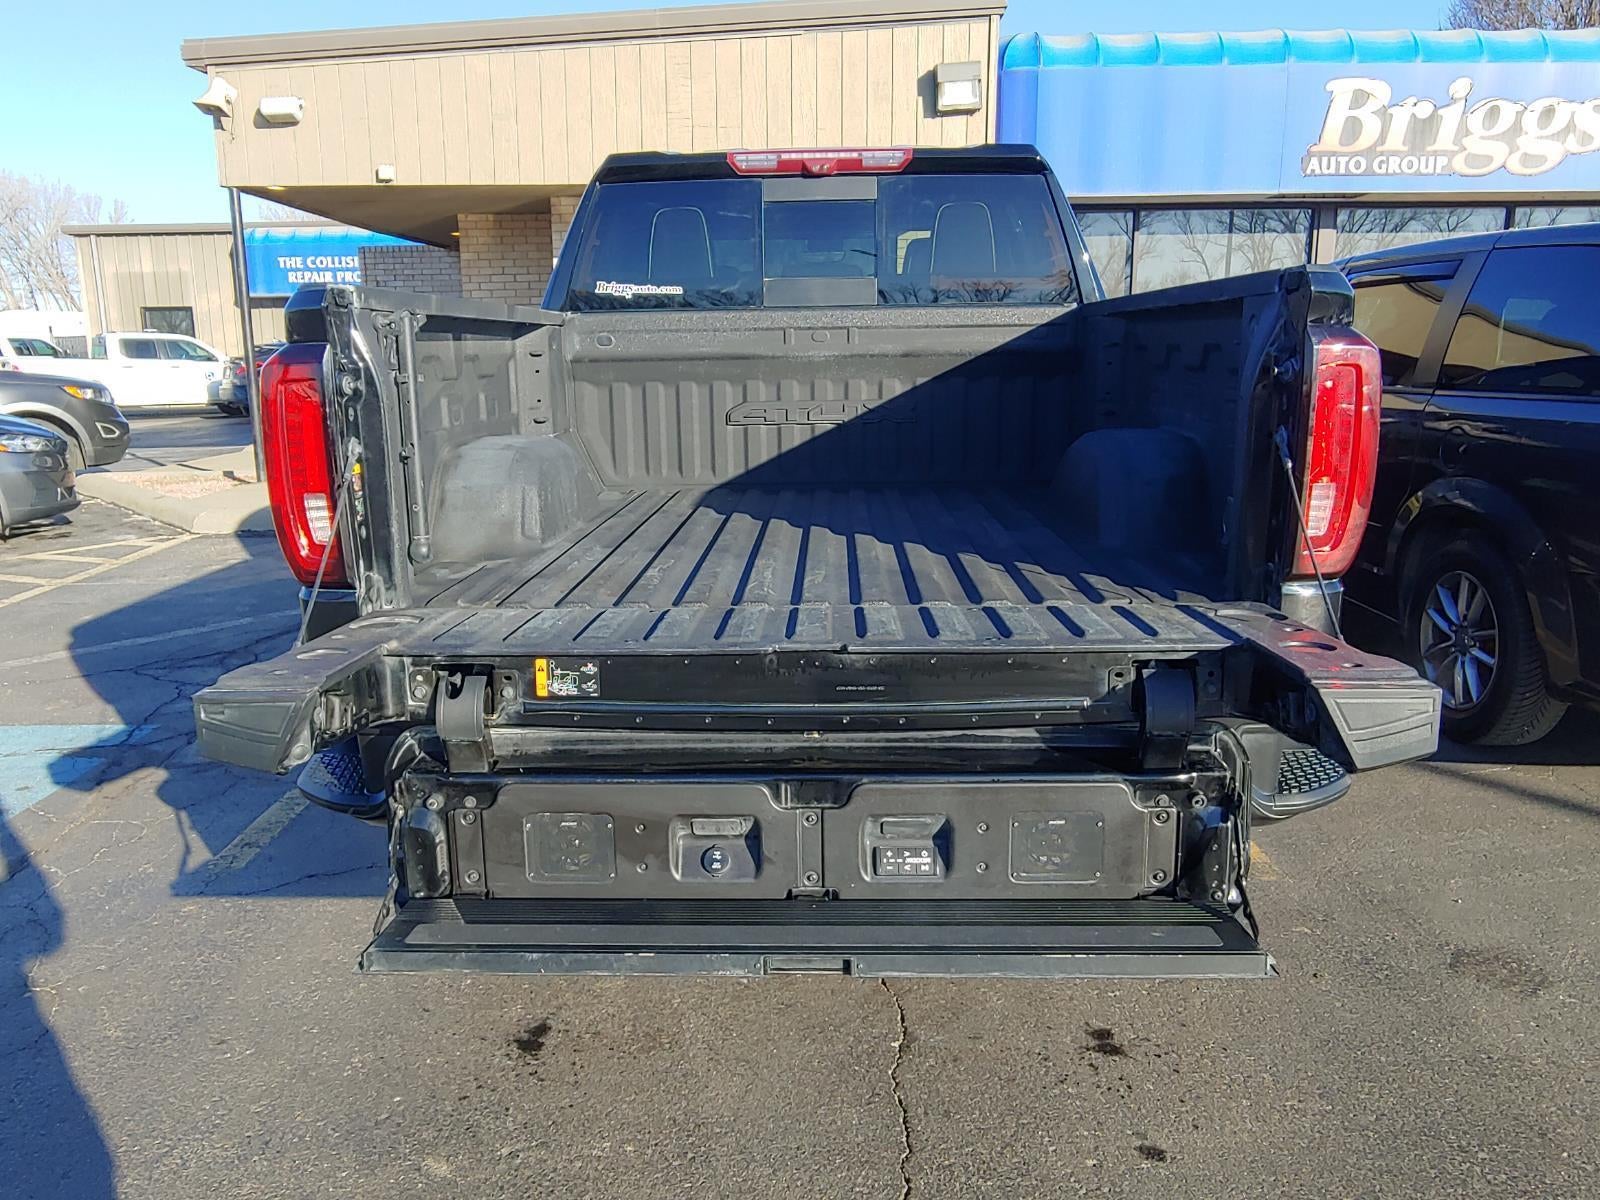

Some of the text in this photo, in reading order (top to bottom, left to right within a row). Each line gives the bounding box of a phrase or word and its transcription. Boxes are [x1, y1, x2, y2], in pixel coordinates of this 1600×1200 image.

[1307, 77, 1600, 177] Briggs
[1306, 155, 1449, 175] AUTO GROUP
[277, 256, 359, 269] THE COLLISI
[287, 271, 362, 283] REPAIR PRO
[595, 281, 683, 299] Briggsauto.com
